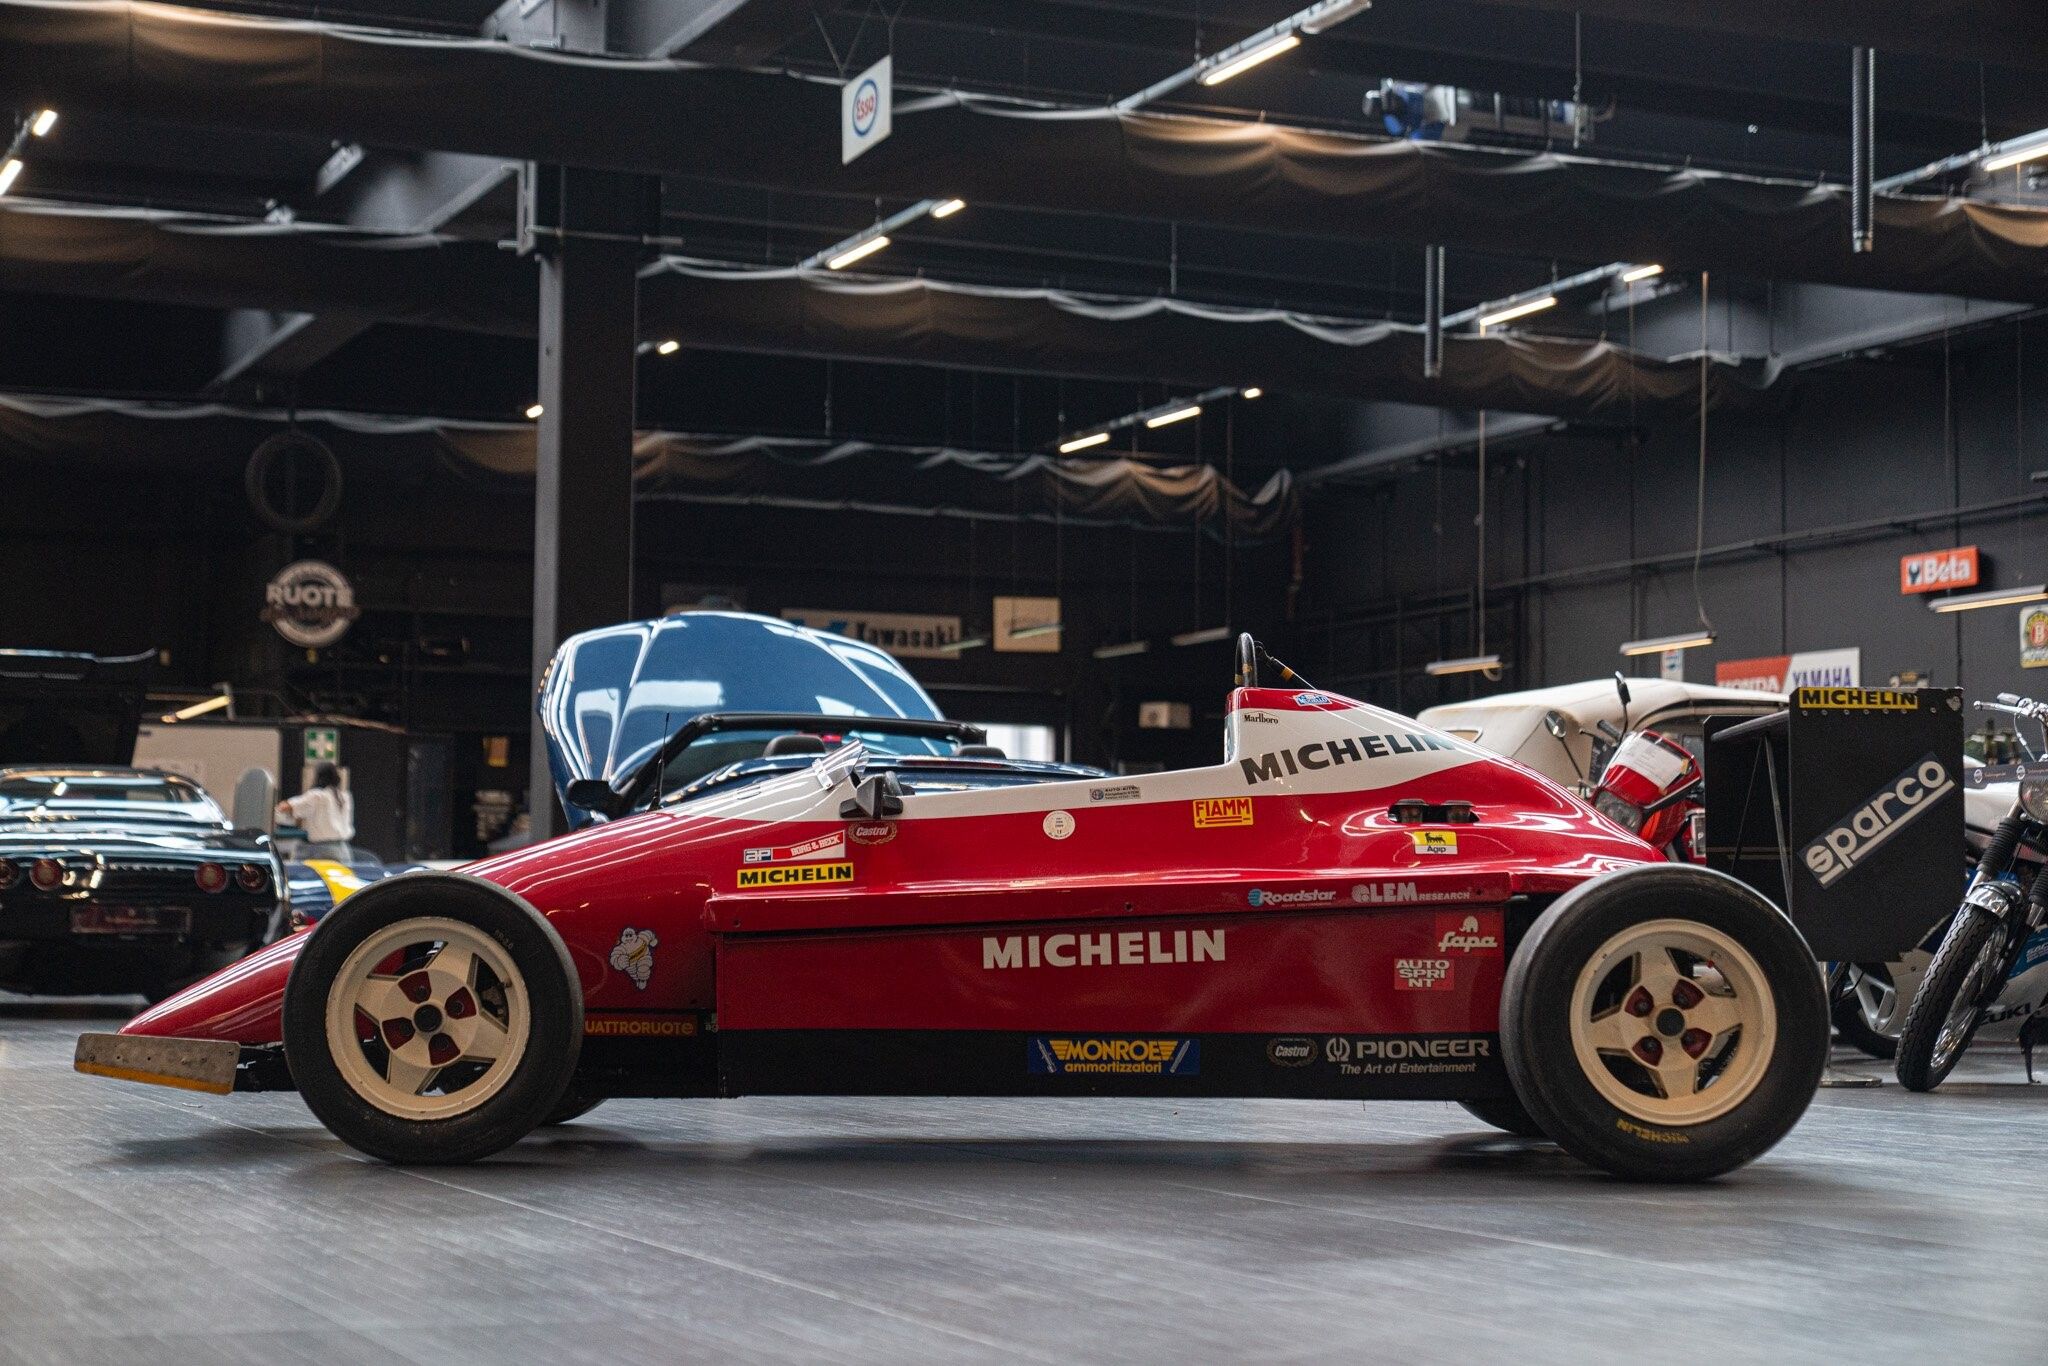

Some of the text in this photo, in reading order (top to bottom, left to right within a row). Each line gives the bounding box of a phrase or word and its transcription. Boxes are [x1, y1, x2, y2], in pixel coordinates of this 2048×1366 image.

[1923, 555, 1970, 584] Beta
[266, 582, 354, 609] RUOTE
[1792, 668, 1852, 687] YAMAHA
[1802, 689, 1918, 707] MICHELIN
[1244, 713, 1279, 725] Marlboro
[1240, 734, 1455, 786] MICHELIN
[1195, 799, 1250, 817] FIAMM
[1804, 759, 1947, 876] sparco
[856, 826, 889, 837] Castrol
[791, 843, 811, 857] BORG
[812, 839, 819, 850] &
[820, 834, 840, 849] BECK
[1426, 845, 1447, 854] Agip
[740, 866, 852, 886] MICHELIN
[1260, 889, 1336, 906] Roadstar
[1418, 891, 1470, 901] RESEARCH
[983, 929, 1226, 969] MICHELIN
[1438, 932, 1498, 952] fapa
[1396, 960, 1450, 970] AUTO
[1063, 1040, 1162, 1061] MONROE
[1275, 1045, 1310, 1058] Castrol
[1356, 1039, 1490, 1059] PIONEER
[1064, 1062, 1162, 1073] ammortizzatori
[1340, 1062, 1477, 1075] The Art of Entertainment
